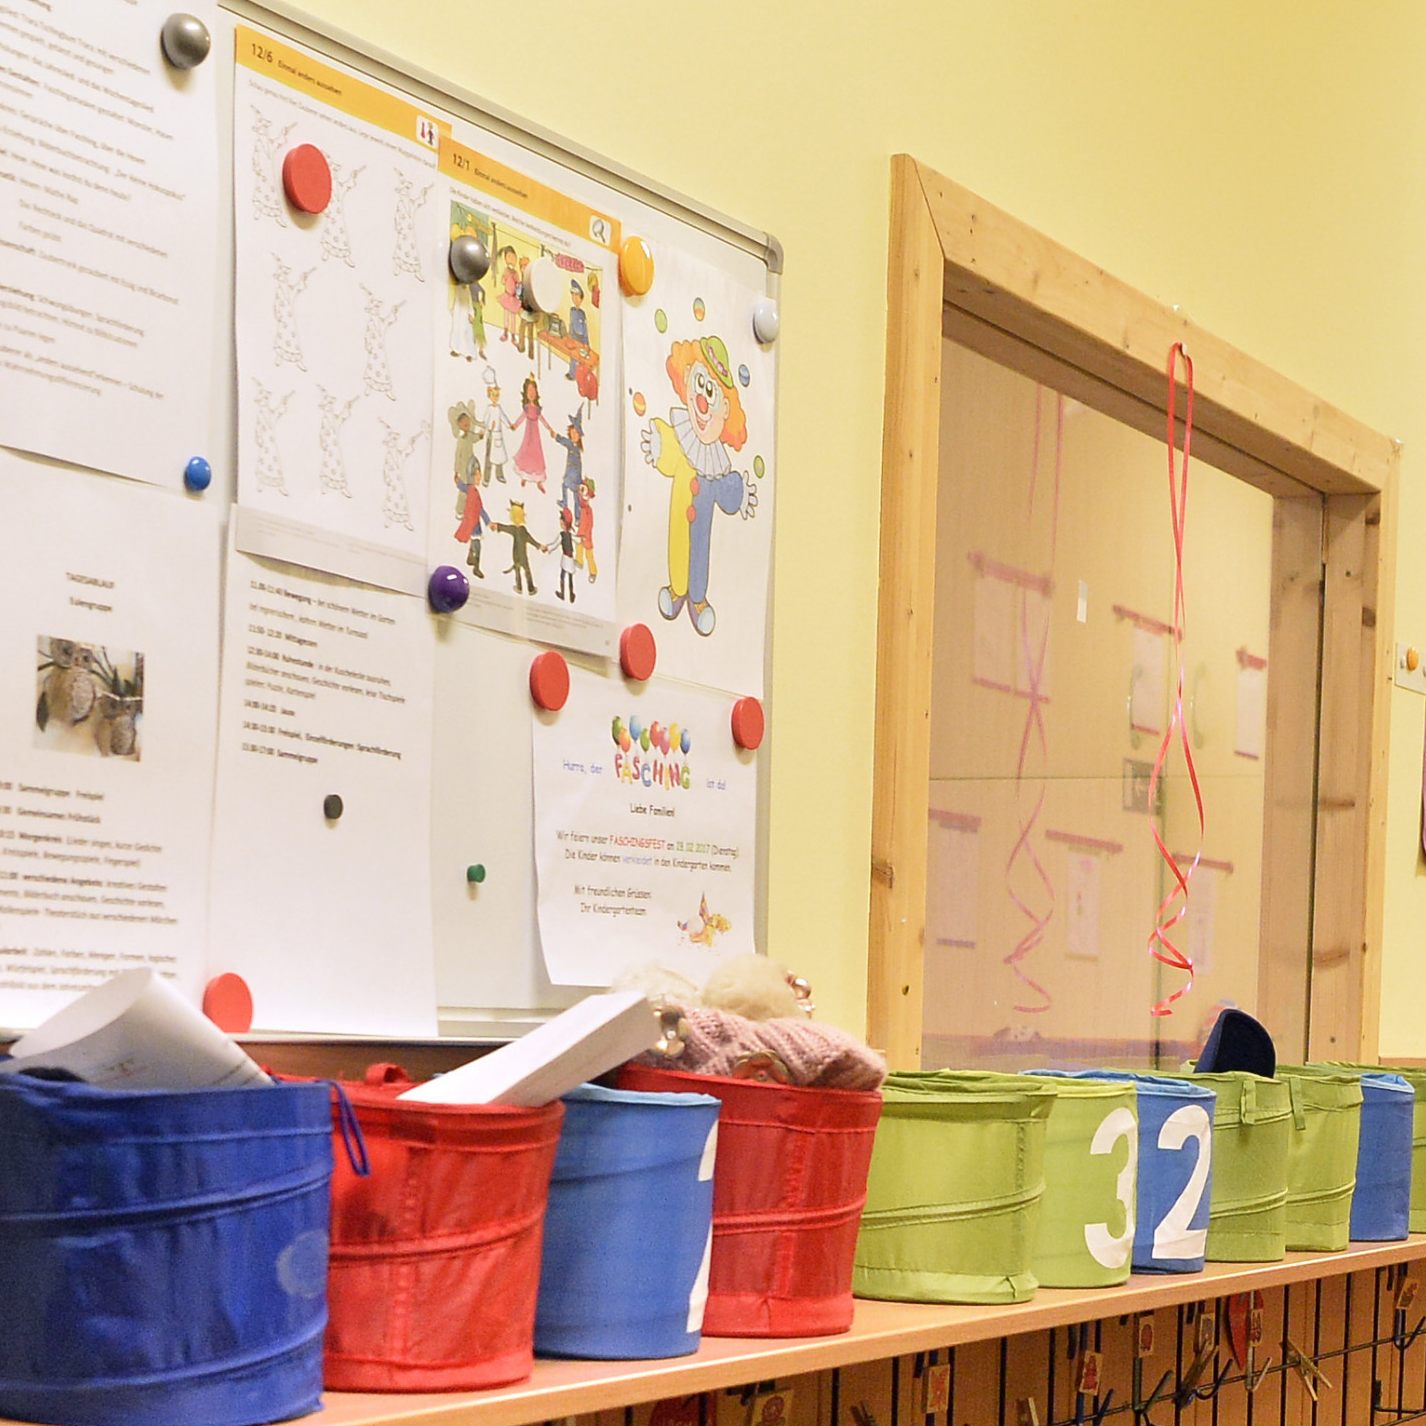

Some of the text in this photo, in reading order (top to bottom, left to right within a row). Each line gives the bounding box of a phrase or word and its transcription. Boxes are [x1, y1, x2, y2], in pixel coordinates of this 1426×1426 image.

[251, 43, 274, 64] 12/6
[452, 153, 471, 172] 12/1
[614, 753, 690, 790] FASCHING
[630, 802, 647, 814] Liebe
[1084, 1107, 1138, 1270] 3
[1152, 1105, 1212, 1260] 2
